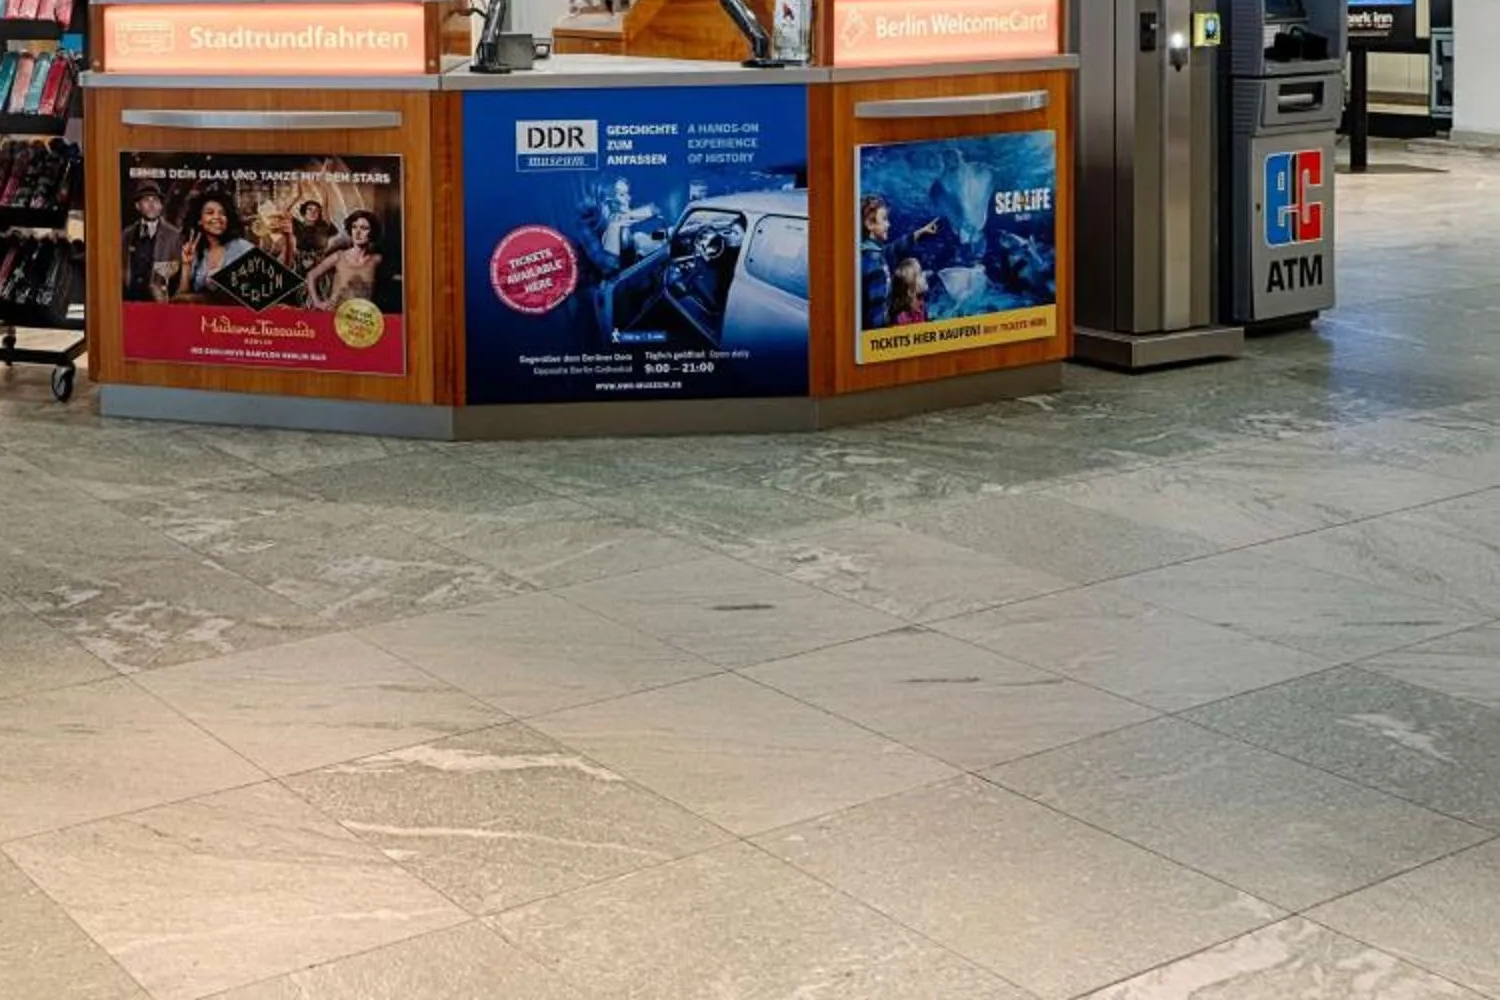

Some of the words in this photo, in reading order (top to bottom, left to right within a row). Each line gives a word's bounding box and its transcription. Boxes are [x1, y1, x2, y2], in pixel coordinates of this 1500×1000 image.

[875, 15, 928, 39] Berlin
[930, 10, 1048, 36] WelcomeCard
[189, 25, 409, 49] Stadtrundfahrten
[527, 126, 585, 149] DDR
[606, 124, 679, 135] GESCHICHTE
[687, 124, 696, 134] A
[697, 123, 759, 134] HANDS-ON
[606, 139, 633, 150] ZUM
[688, 138, 758, 149] EXPERIENCE
[606, 154, 668, 165] ANFASSEN
[687, 154, 704, 164] OF
[705, 153, 754, 164] HISTORY
[168, 168, 197, 180] DEIN
[199, 169, 229, 180] GLAS
[229, 169, 256, 181] UND
[259, 170, 298, 181] TANZE
[300, 171, 321, 182] MIT
[351, 173, 391, 184] STARS
[995, 190, 1021, 215] SEA
[508, 248, 553, 269] TICKETS
[507, 259, 563, 285] AVAILABLE
[1266, 254, 1323, 293] ATM
[524, 278, 553, 293] HERE
[200, 315, 260, 336] Madame
[257, 319, 316, 339] Tussauds
[870, 335, 911, 351] TICKETS
[913, 330, 937, 345] HIER
[939, 324, 981, 341] KAUFEN!
